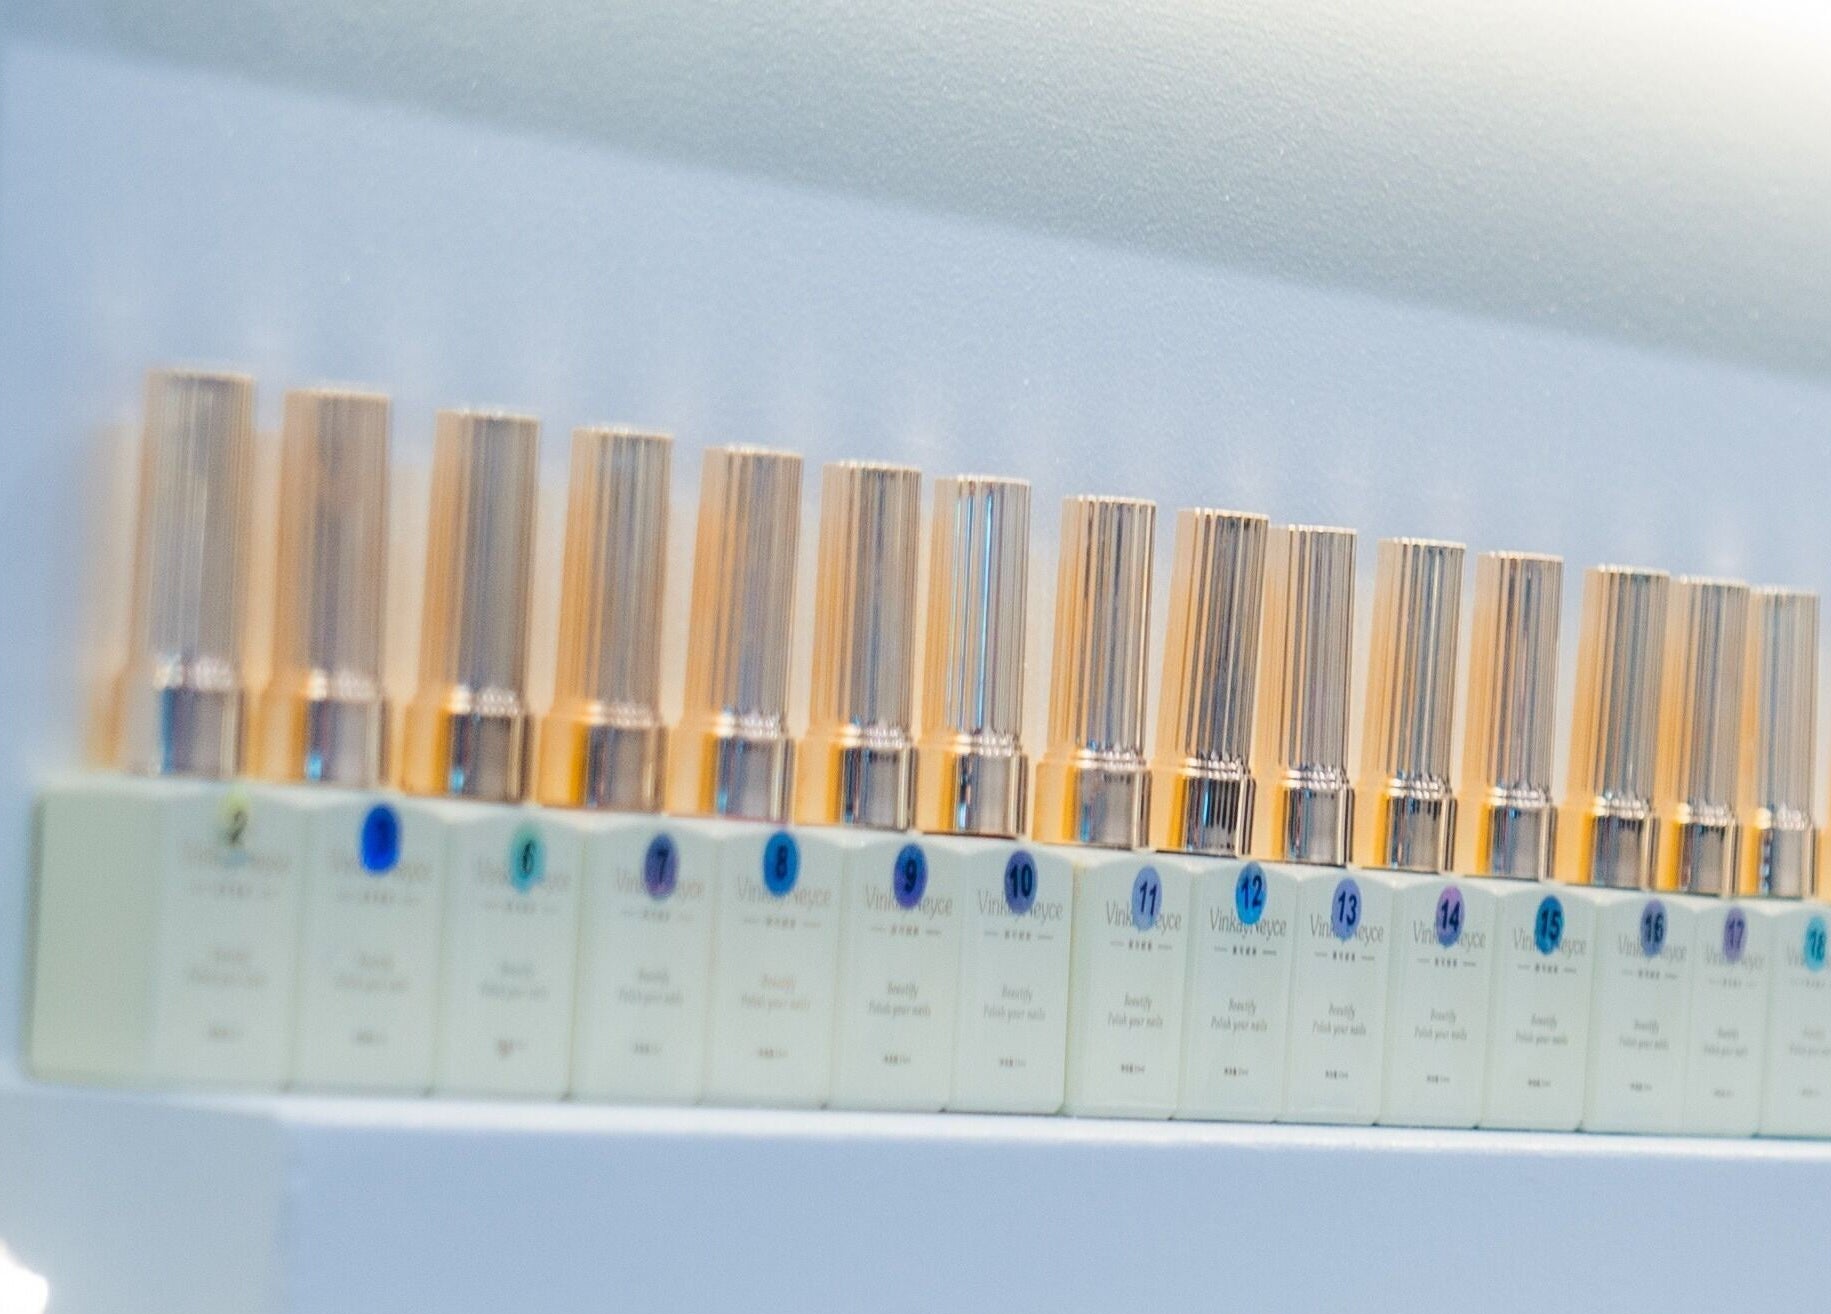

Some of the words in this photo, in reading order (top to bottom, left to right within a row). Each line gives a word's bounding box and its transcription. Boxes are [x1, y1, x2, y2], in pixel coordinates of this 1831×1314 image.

[657, 848, 670, 884] 7
[904, 859, 917, 893] 9
[1010, 863, 1033, 898] 10
[1140, 881, 1157, 917] 11
[1242, 875, 1262, 910] 12
[1338, 891, 1357, 926] 13
[1441, 899, 1460, 932] 14
[1541, 910, 1561, 941] 15
[1645, 912, 1664, 942] 16
